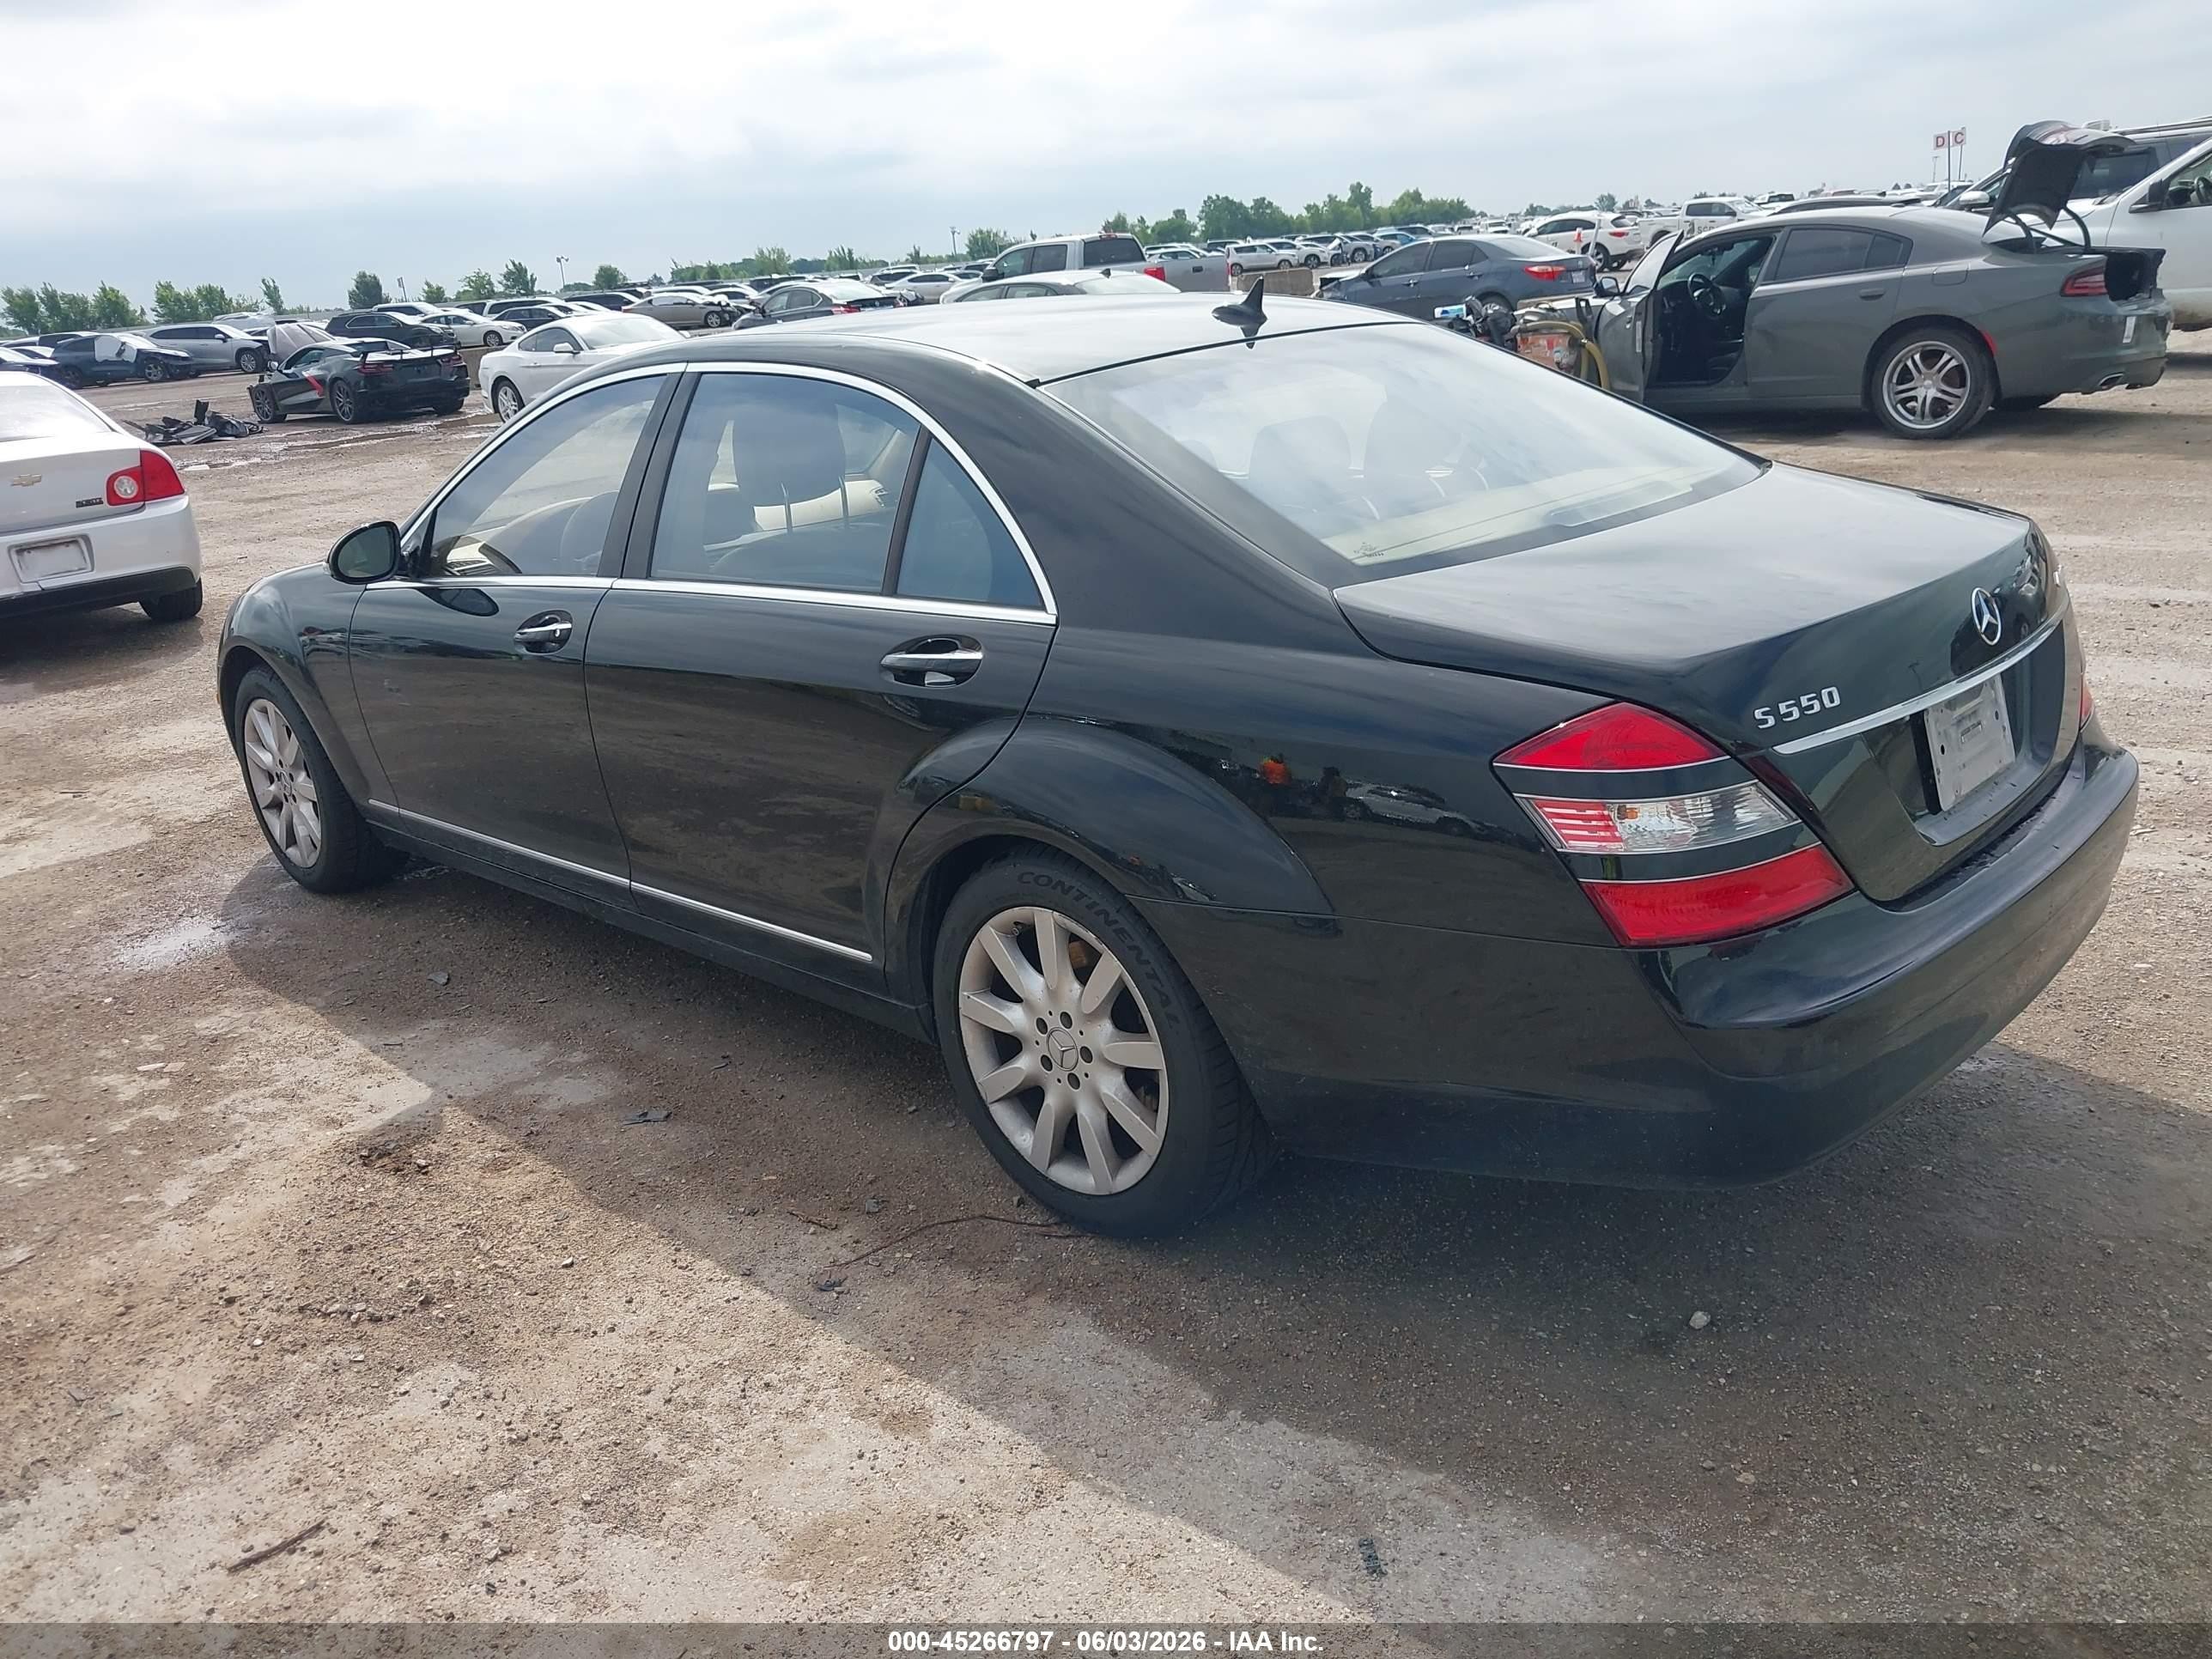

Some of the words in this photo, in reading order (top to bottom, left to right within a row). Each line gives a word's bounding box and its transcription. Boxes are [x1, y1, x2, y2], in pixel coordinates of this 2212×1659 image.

[1936, 136, 1945, 148] D
[1954, 131, 1965, 144] C
[1017, 871, 1180, 1029] CONTINENTAL
